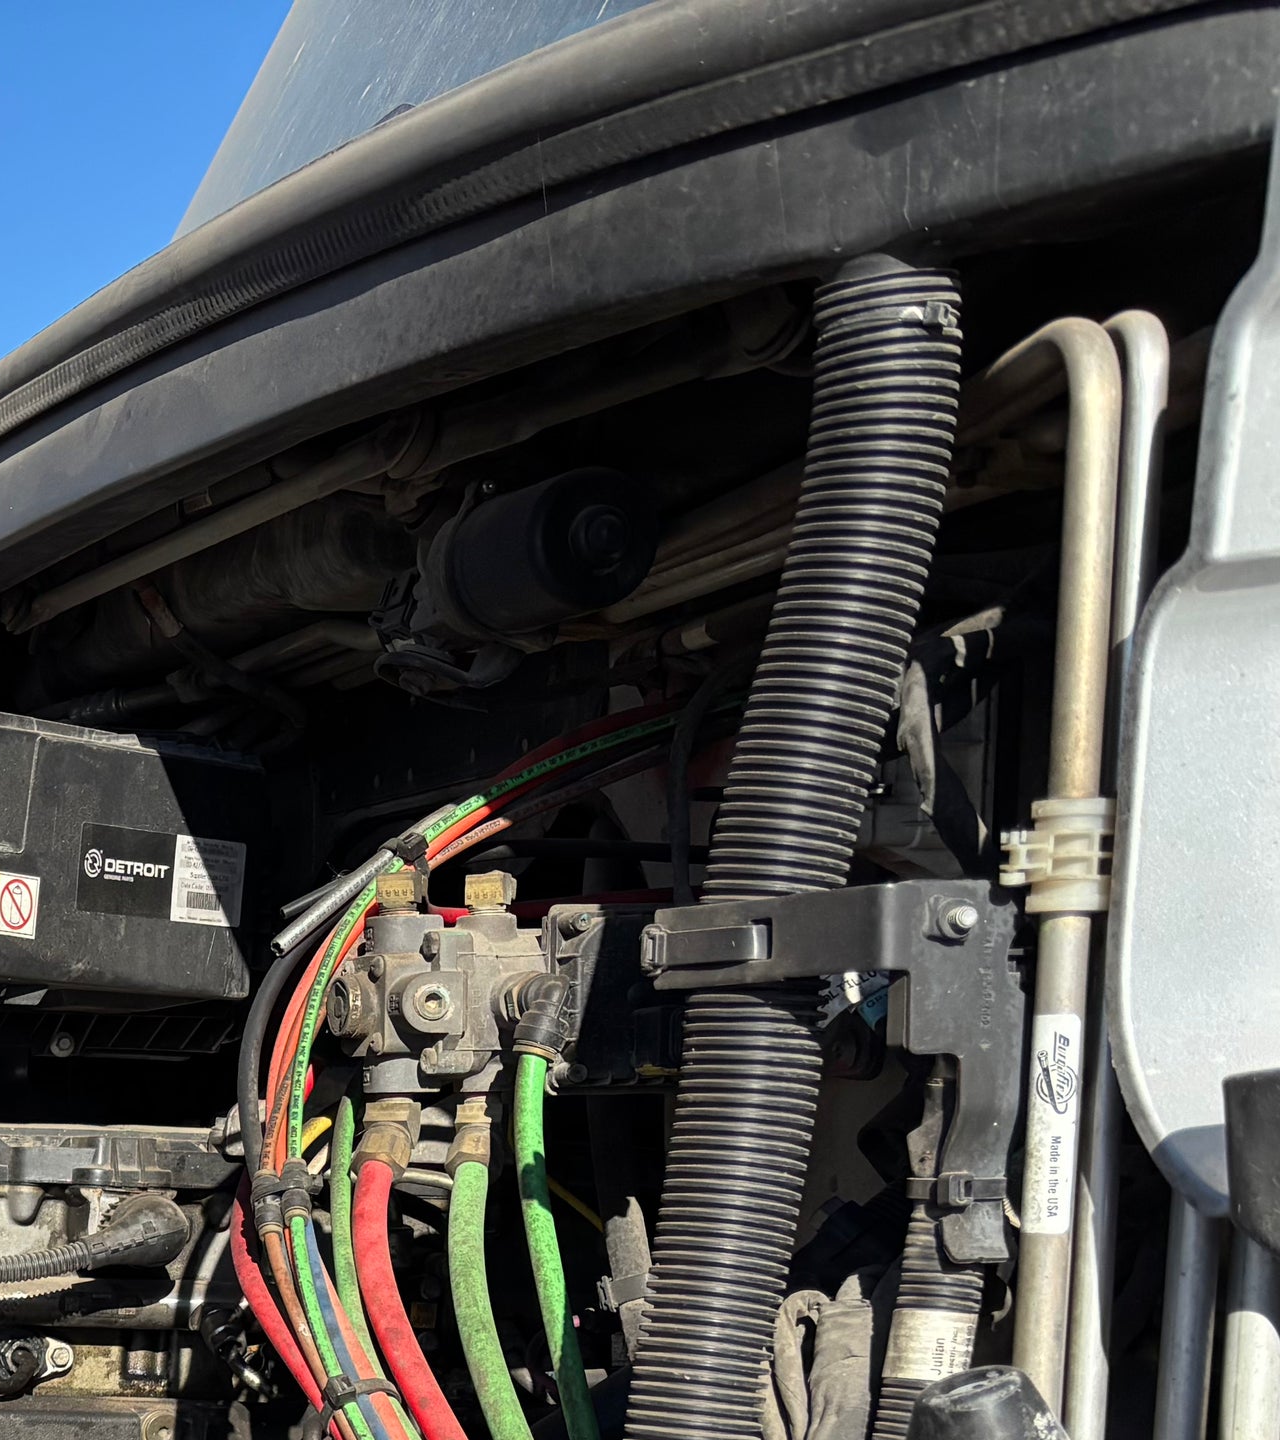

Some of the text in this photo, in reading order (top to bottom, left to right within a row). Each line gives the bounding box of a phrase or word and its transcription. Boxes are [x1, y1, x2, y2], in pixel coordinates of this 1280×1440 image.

[104, 858, 170, 879] DETROIT
[1046, 1135, 1062, 1218] Made in the USA
[930, 1337, 946, 1375] Julian
